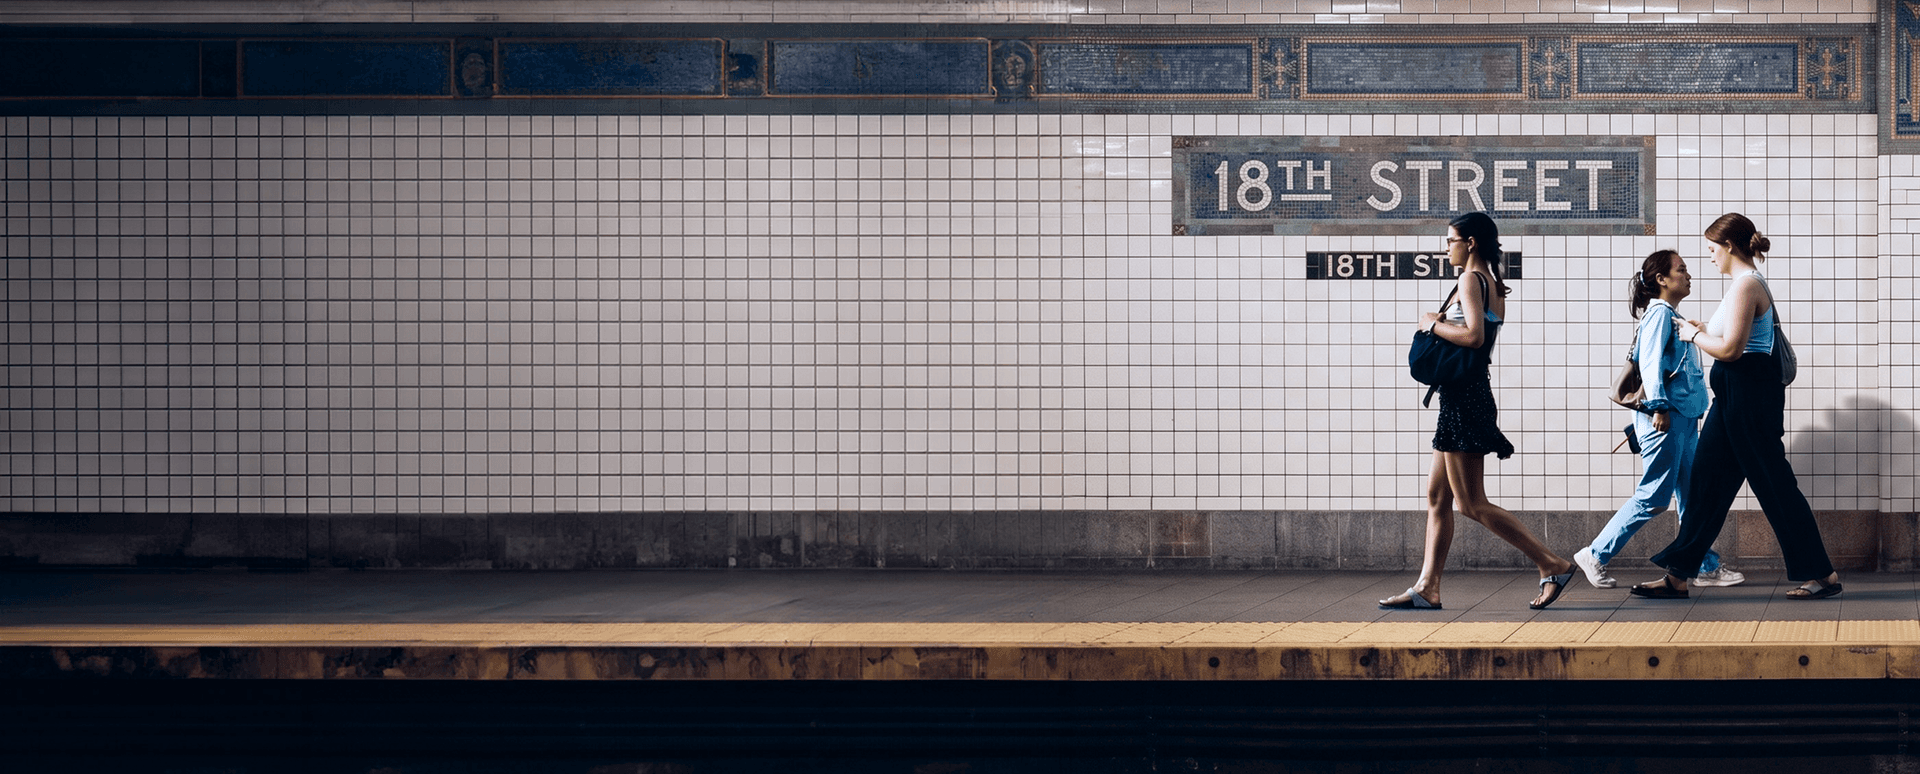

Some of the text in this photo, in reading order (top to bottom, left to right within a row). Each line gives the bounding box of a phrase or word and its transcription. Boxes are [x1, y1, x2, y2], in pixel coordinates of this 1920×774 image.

[1214, 160, 1613, 212] 18TH STREET
[1327, 254, 1396, 277] 18TH
